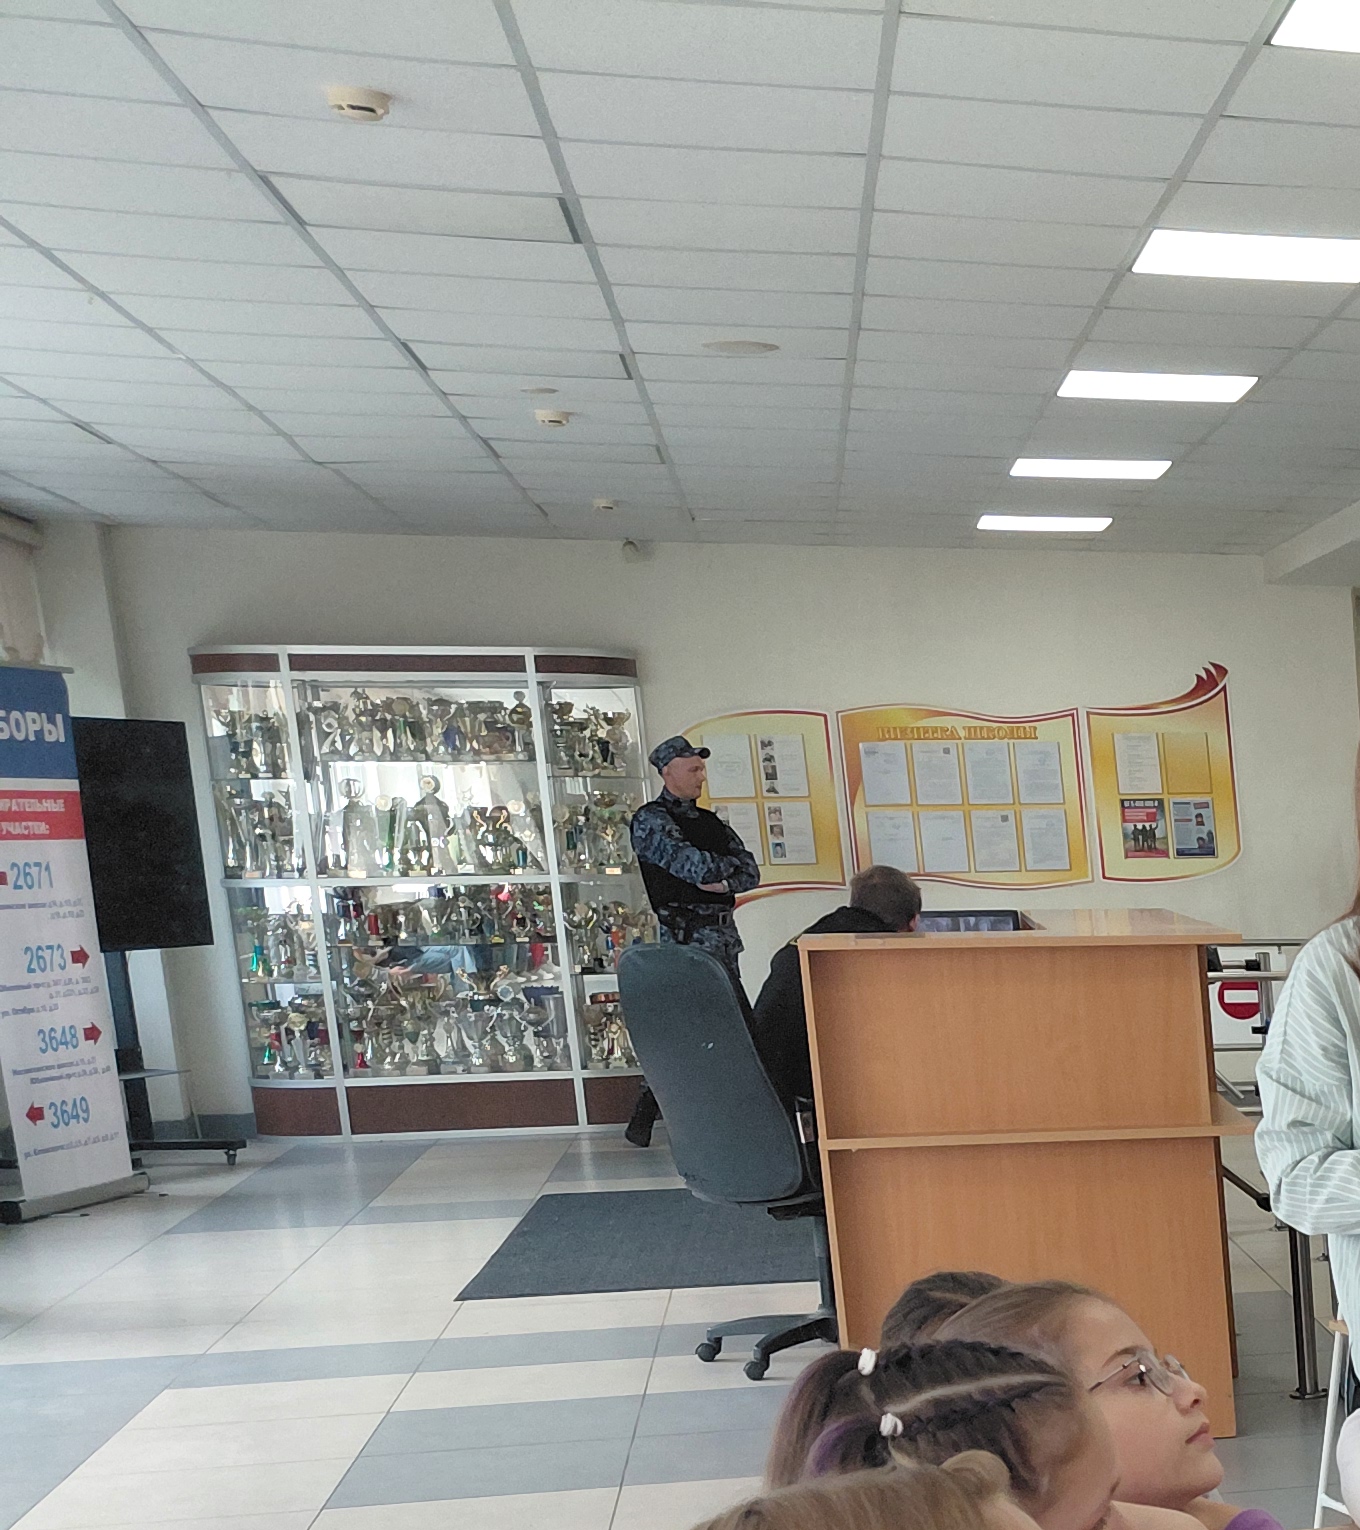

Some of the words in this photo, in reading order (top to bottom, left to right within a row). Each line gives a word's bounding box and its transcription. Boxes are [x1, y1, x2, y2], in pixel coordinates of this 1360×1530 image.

[10, 861, 54, 890] 2671
[24, 943, 67, 974] 2673
[37, 1024, 80, 1054] 3648
[48, 1095, 91, 1129] 3649
